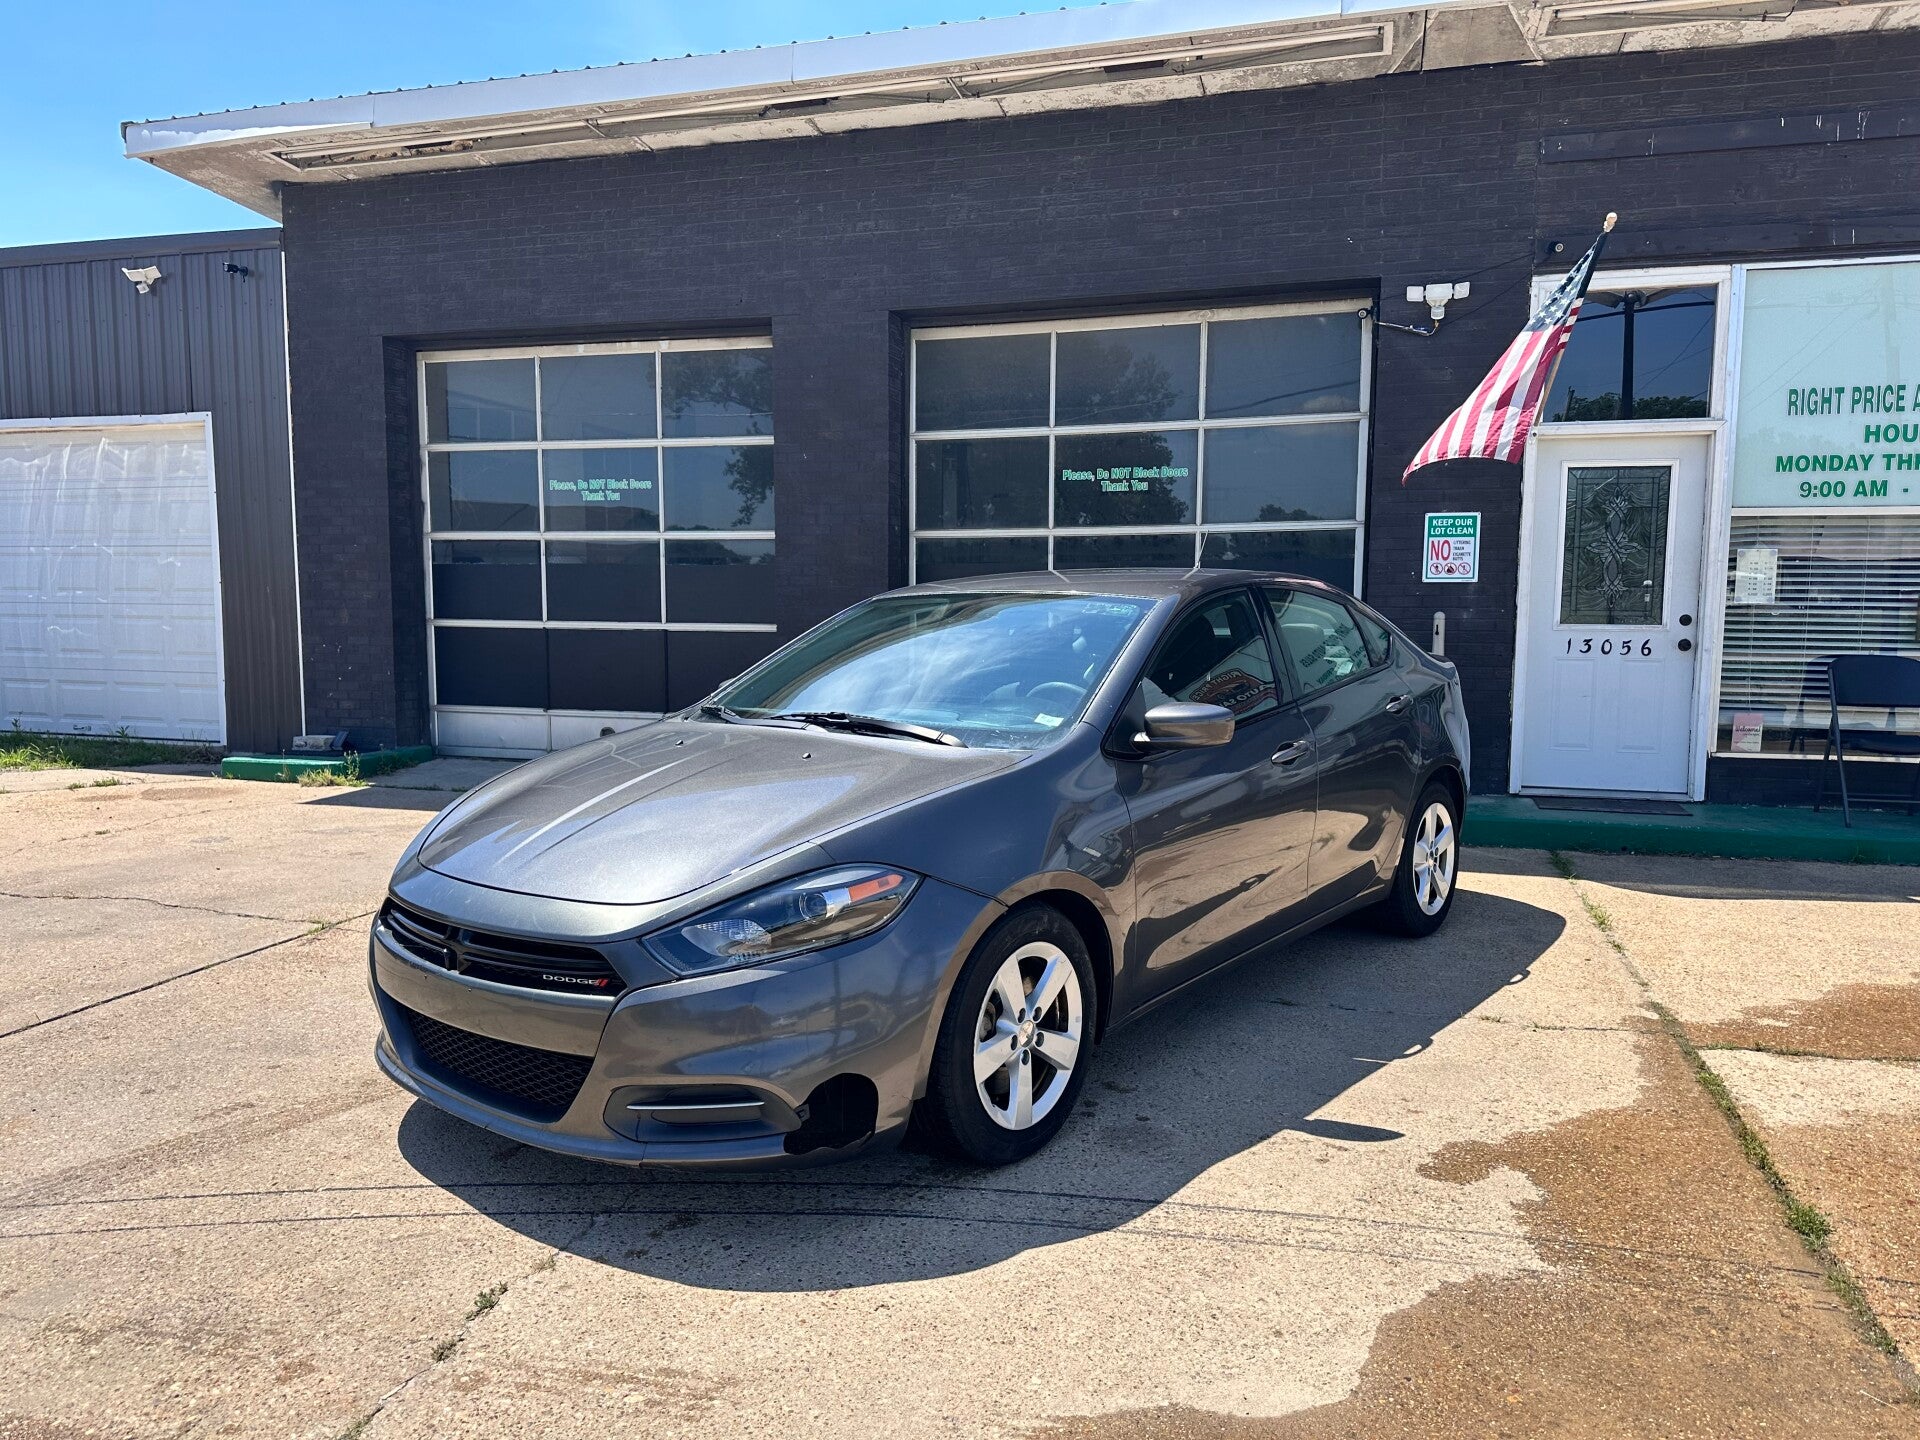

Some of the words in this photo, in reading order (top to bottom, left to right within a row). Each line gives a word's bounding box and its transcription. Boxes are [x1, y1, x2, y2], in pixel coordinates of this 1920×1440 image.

[1787, 386, 1845, 416] RIGHT
[1851, 384, 1907, 414] PRICE
[1775, 454, 1875, 473] MONDAY
[1062, 469, 1095, 482] Please,
[1096, 468, 1109, 479] Do
[1111, 467, 1131, 479] NOT
[1133, 466, 1159, 479] Block
[1161, 466, 1189, 478] Doors
[549, 479, 577, 491] Please,
[577, 479, 588, 489] Do
[589, 479, 606, 489] NOT
[606, 478, 629, 489] Block
[629, 478, 652, 489] Doors
[1100, 480, 1129, 492] Thank
[1131, 480, 1149, 491] You
[1799, 480, 1846, 498] 9:00
[1853, 479, 1888, 497] AM
[581, 491, 605, 501] Thank
[605, 490, 621, 501] You
[1432, 518, 1454, 526] KEEP
[1455, 518, 1473, 526] OUR
[1430, 527, 1446, 535] LOT
[1446, 527, 1474, 535] CLEAN
[1430, 539, 1451, 561] NO
[1566, 637, 1652, 657] 13056
[542, 974, 599, 986] DODGE
